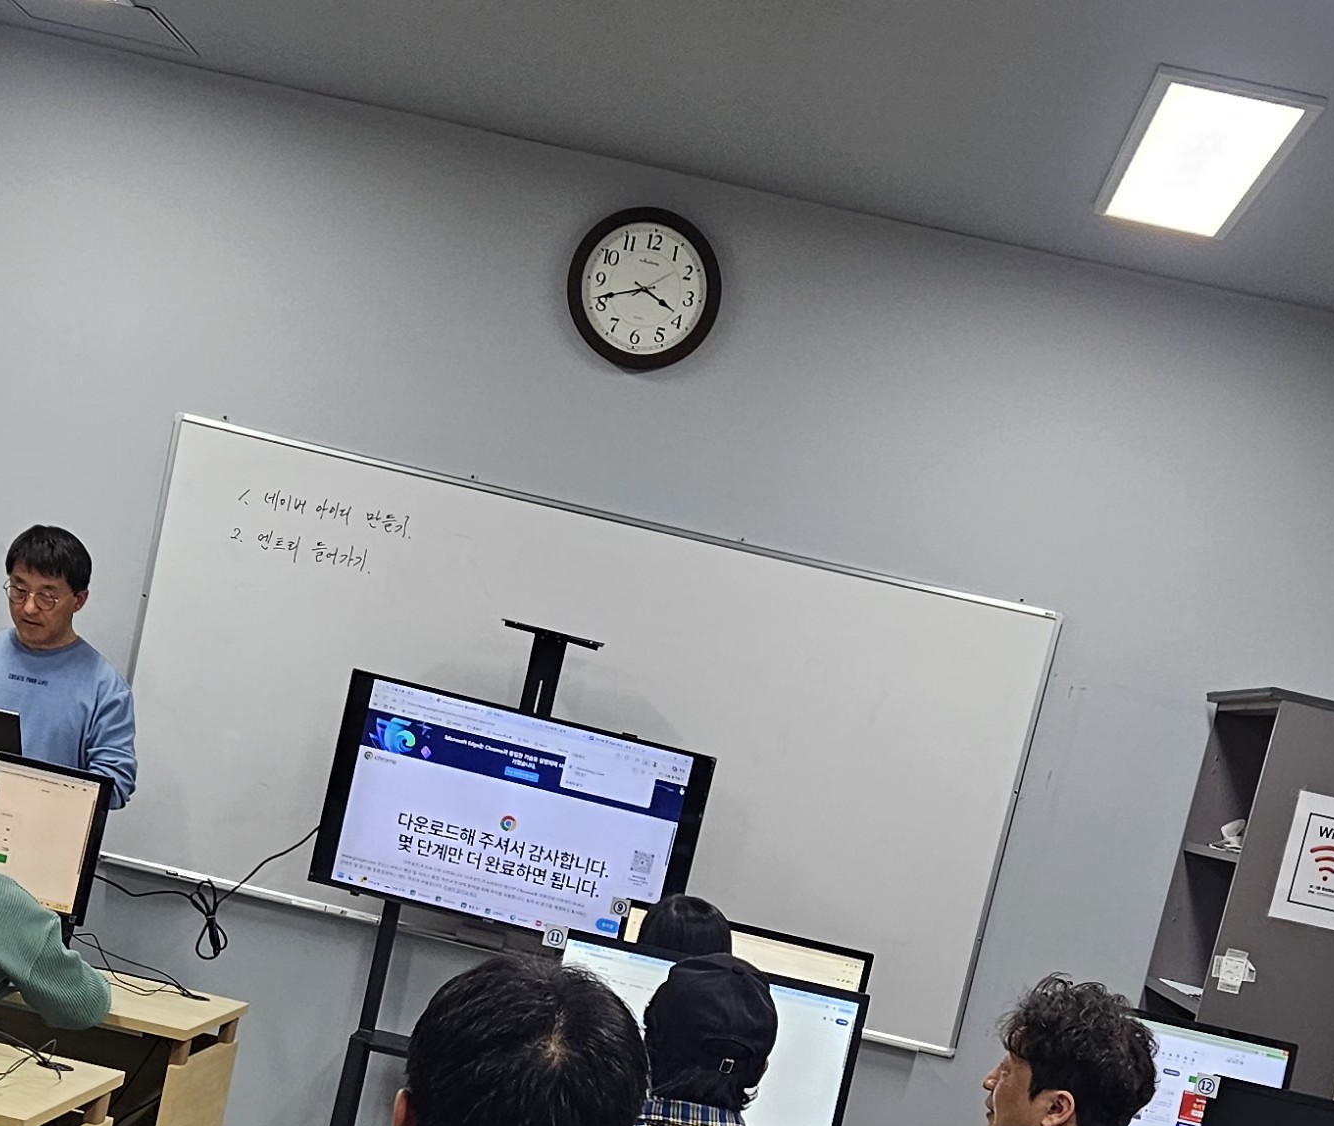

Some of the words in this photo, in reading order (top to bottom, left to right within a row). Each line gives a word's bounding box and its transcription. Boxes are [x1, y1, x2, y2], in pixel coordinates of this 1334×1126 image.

[623, 234, 636, 251] 11
[647, 233, 663, 251] 12
[603, 248, 620, 266] 10
[672, 245, 679, 262] 1
[595, 271, 606, 287] 9
[682, 264, 694, 281] 2
[595, 296, 608, 311] 8
[682, 290, 694, 307] 3
[610, 317, 620, 333] 7
[670, 314, 682, 329] 4
[629, 328, 641, 344] 6
[654, 326, 666, 342] 5
[264, 490, 306, 515] 네이버
[316, 498, 352, 526] 아이디
[230, 527, 243, 542] 2.
[257, 530, 301, 563] 엔트리
[397, 812, 476, 846] 다운로드해
[478, 831, 526, 859] 주셔서
[528, 843, 609, 879] 감사합니다.
[398, 834, 414, 853] 몇
[417, 839, 464, 865] 단계만
[466, 851, 483, 870] 더
[485, 855, 548, 886] 완료하면
[549, 872, 600, 898] 됩니다.
